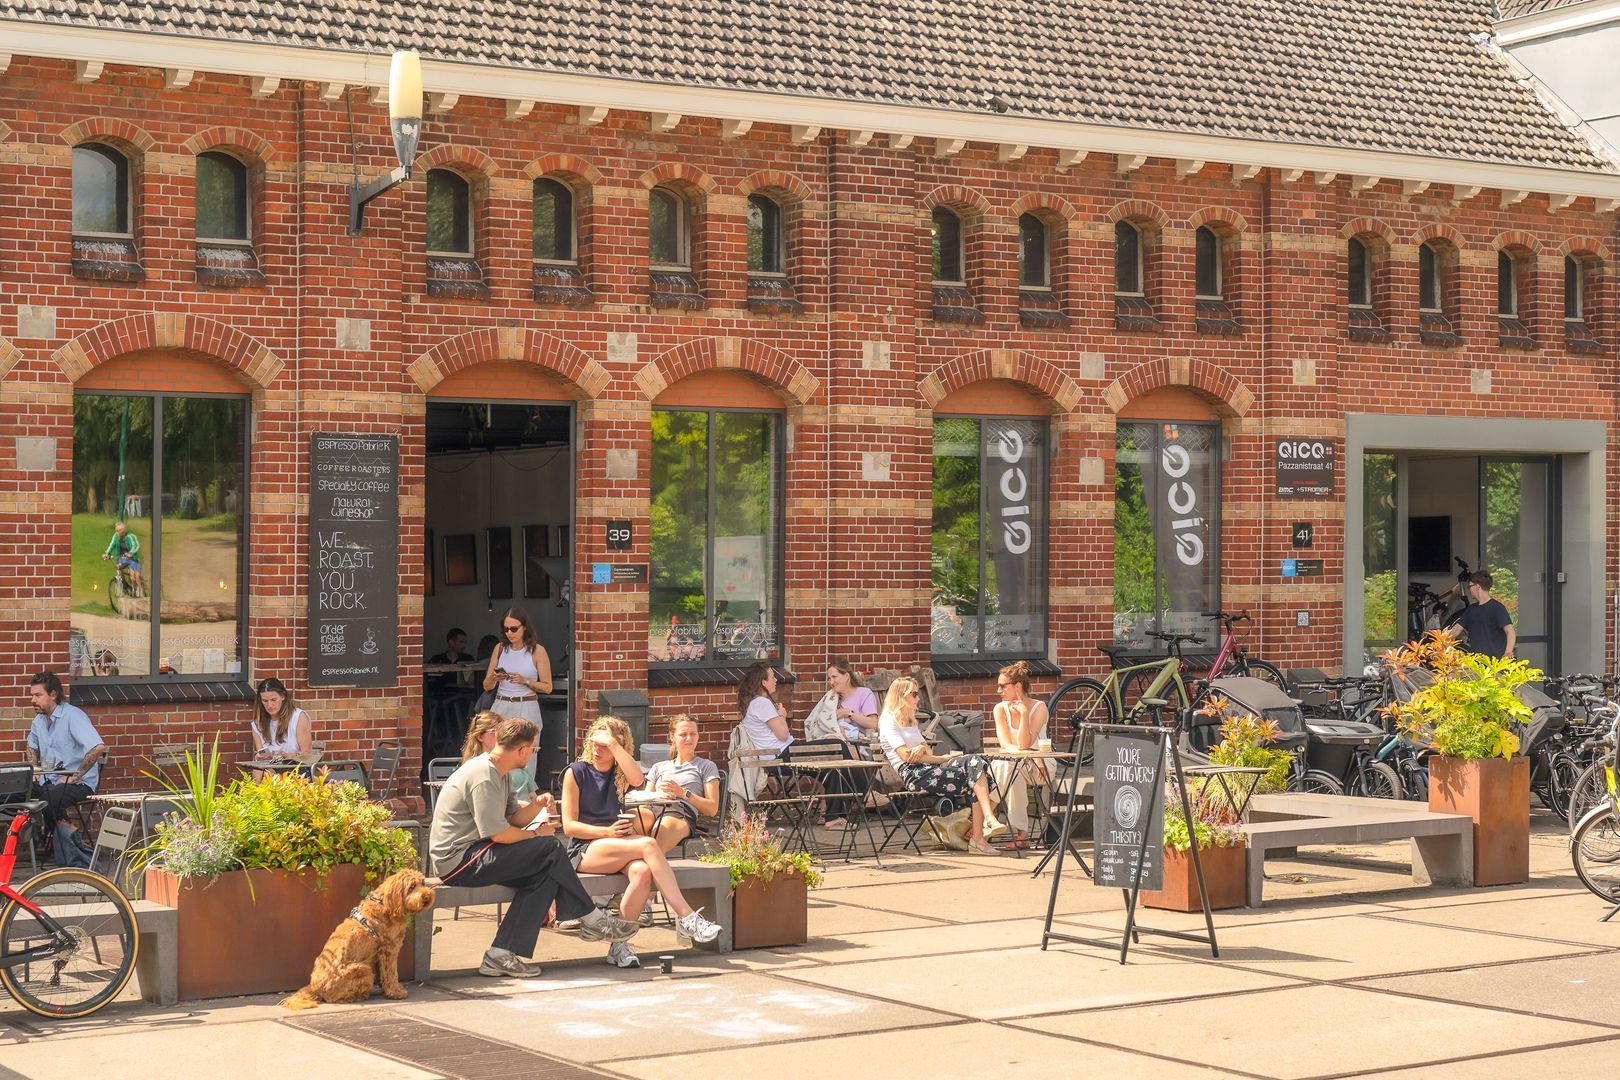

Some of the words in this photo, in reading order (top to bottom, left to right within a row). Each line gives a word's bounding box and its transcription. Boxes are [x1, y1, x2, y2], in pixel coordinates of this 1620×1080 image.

[317, 464, 350, 472] COFFEE
[351, 465, 391, 474] ROASTERS
[1278, 461, 1324, 470] Pazzanistraat
[1325, 462, 1333, 470] 41
[357, 481, 390, 492] coffee
[318, 531, 343, 548] WE
[609, 529, 630, 541] 39
[1296, 529, 1309, 540] 41
[318, 571, 355, 591] YOU
[320, 634, 345, 644] inside
[322, 666, 379, 675] espressofabriek.nl
[1105, 765, 1135, 782] GETTING
[1134, 766, 1154, 784] VERY
[1110, 831, 1137, 844] THIRSTY
